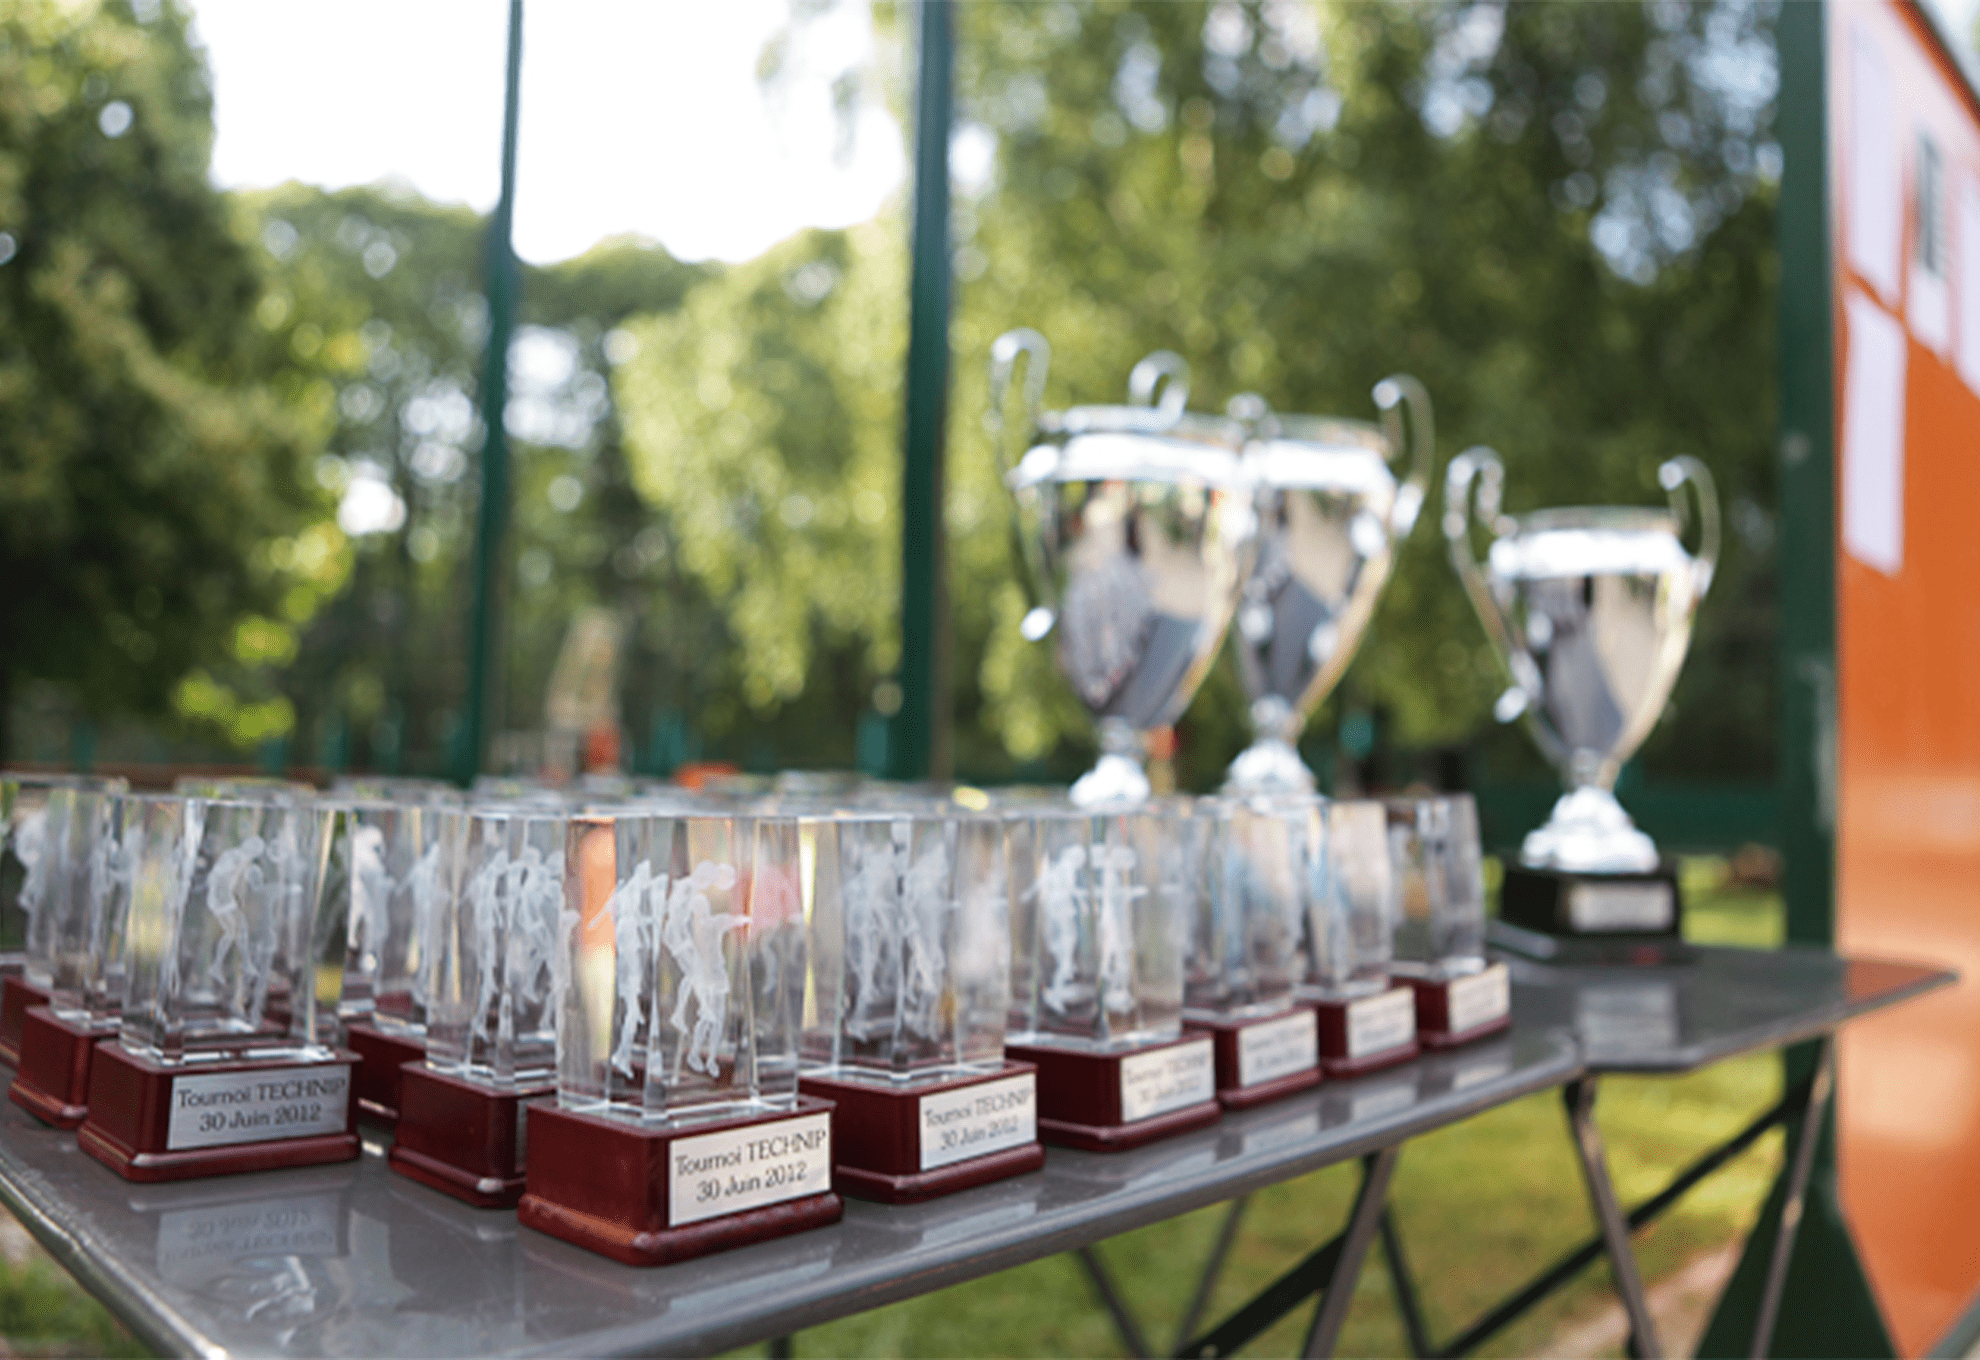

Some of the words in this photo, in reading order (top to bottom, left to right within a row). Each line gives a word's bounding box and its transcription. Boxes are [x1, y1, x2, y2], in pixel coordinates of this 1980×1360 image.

[177, 1086, 251, 1108] Tournoi
[255, 1077, 346, 1101] TECHNIP
[199, 1111, 226, 1132] 30
[228, 1109, 270, 1129] Juin
[274, 1103, 321, 1126] 2012
[925, 1103, 971, 1127] Tournoi
[941, 1128, 959, 1151] 30
[960, 1126, 987, 1146] Juin
[988, 1114, 1019, 1139] 2012
[675, 1145, 742, 1176] Tournoi
[746, 1128, 826, 1162] TECHNIP
[697, 1178, 721, 1202] 30
[724, 1174, 761, 1197] Juin
[765, 1160, 807, 1188] 2012
